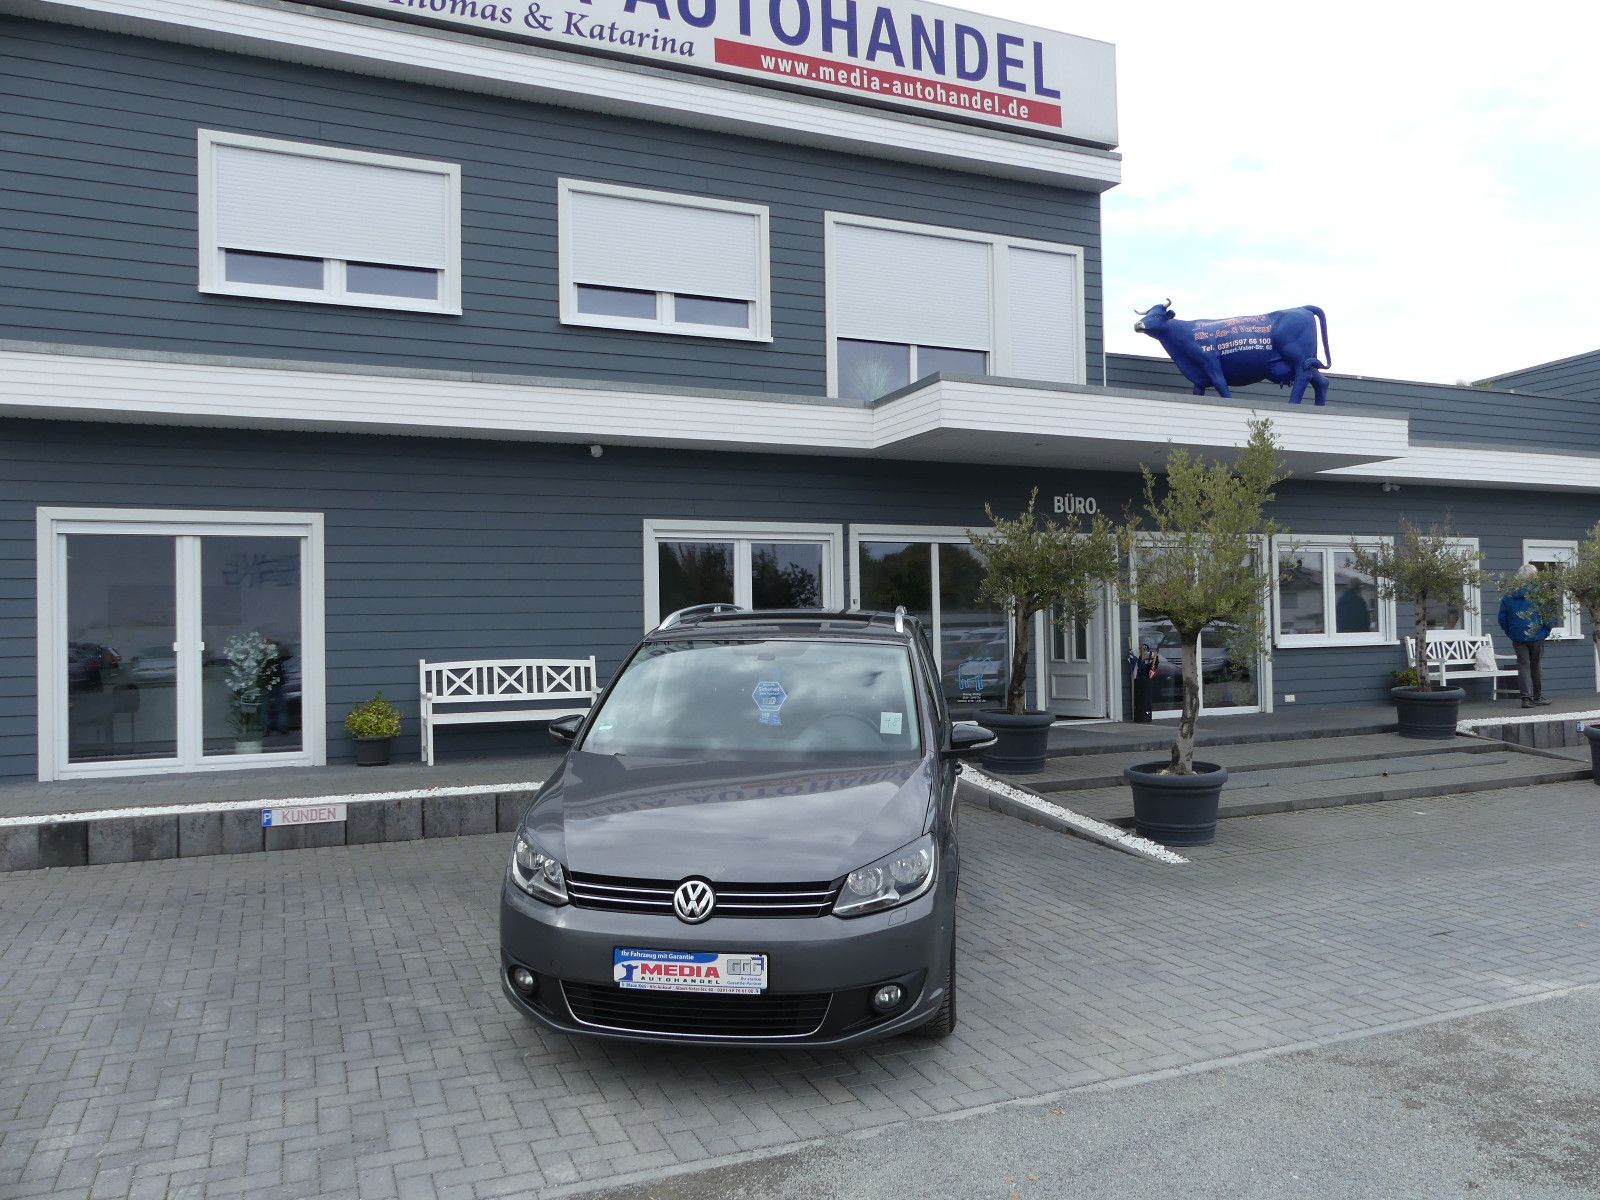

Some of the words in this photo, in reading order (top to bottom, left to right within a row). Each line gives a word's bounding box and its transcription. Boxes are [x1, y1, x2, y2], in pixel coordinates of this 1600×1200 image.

[388, 0, 513, 24] omas
[523, 2, 553, 32] &
[562, 11, 696, 58] Katarina
[760, 54, 1029, 119] www.media-autohandel.de
[1202, 344, 1215, 352] Tel.
[282, 807, 336, 823] KUNDEN
[630, 951, 657, 960] Fahrzeug
[640, 963, 721, 978] MEDIA
[641, 976, 721, 985] AUTOHANDEL
